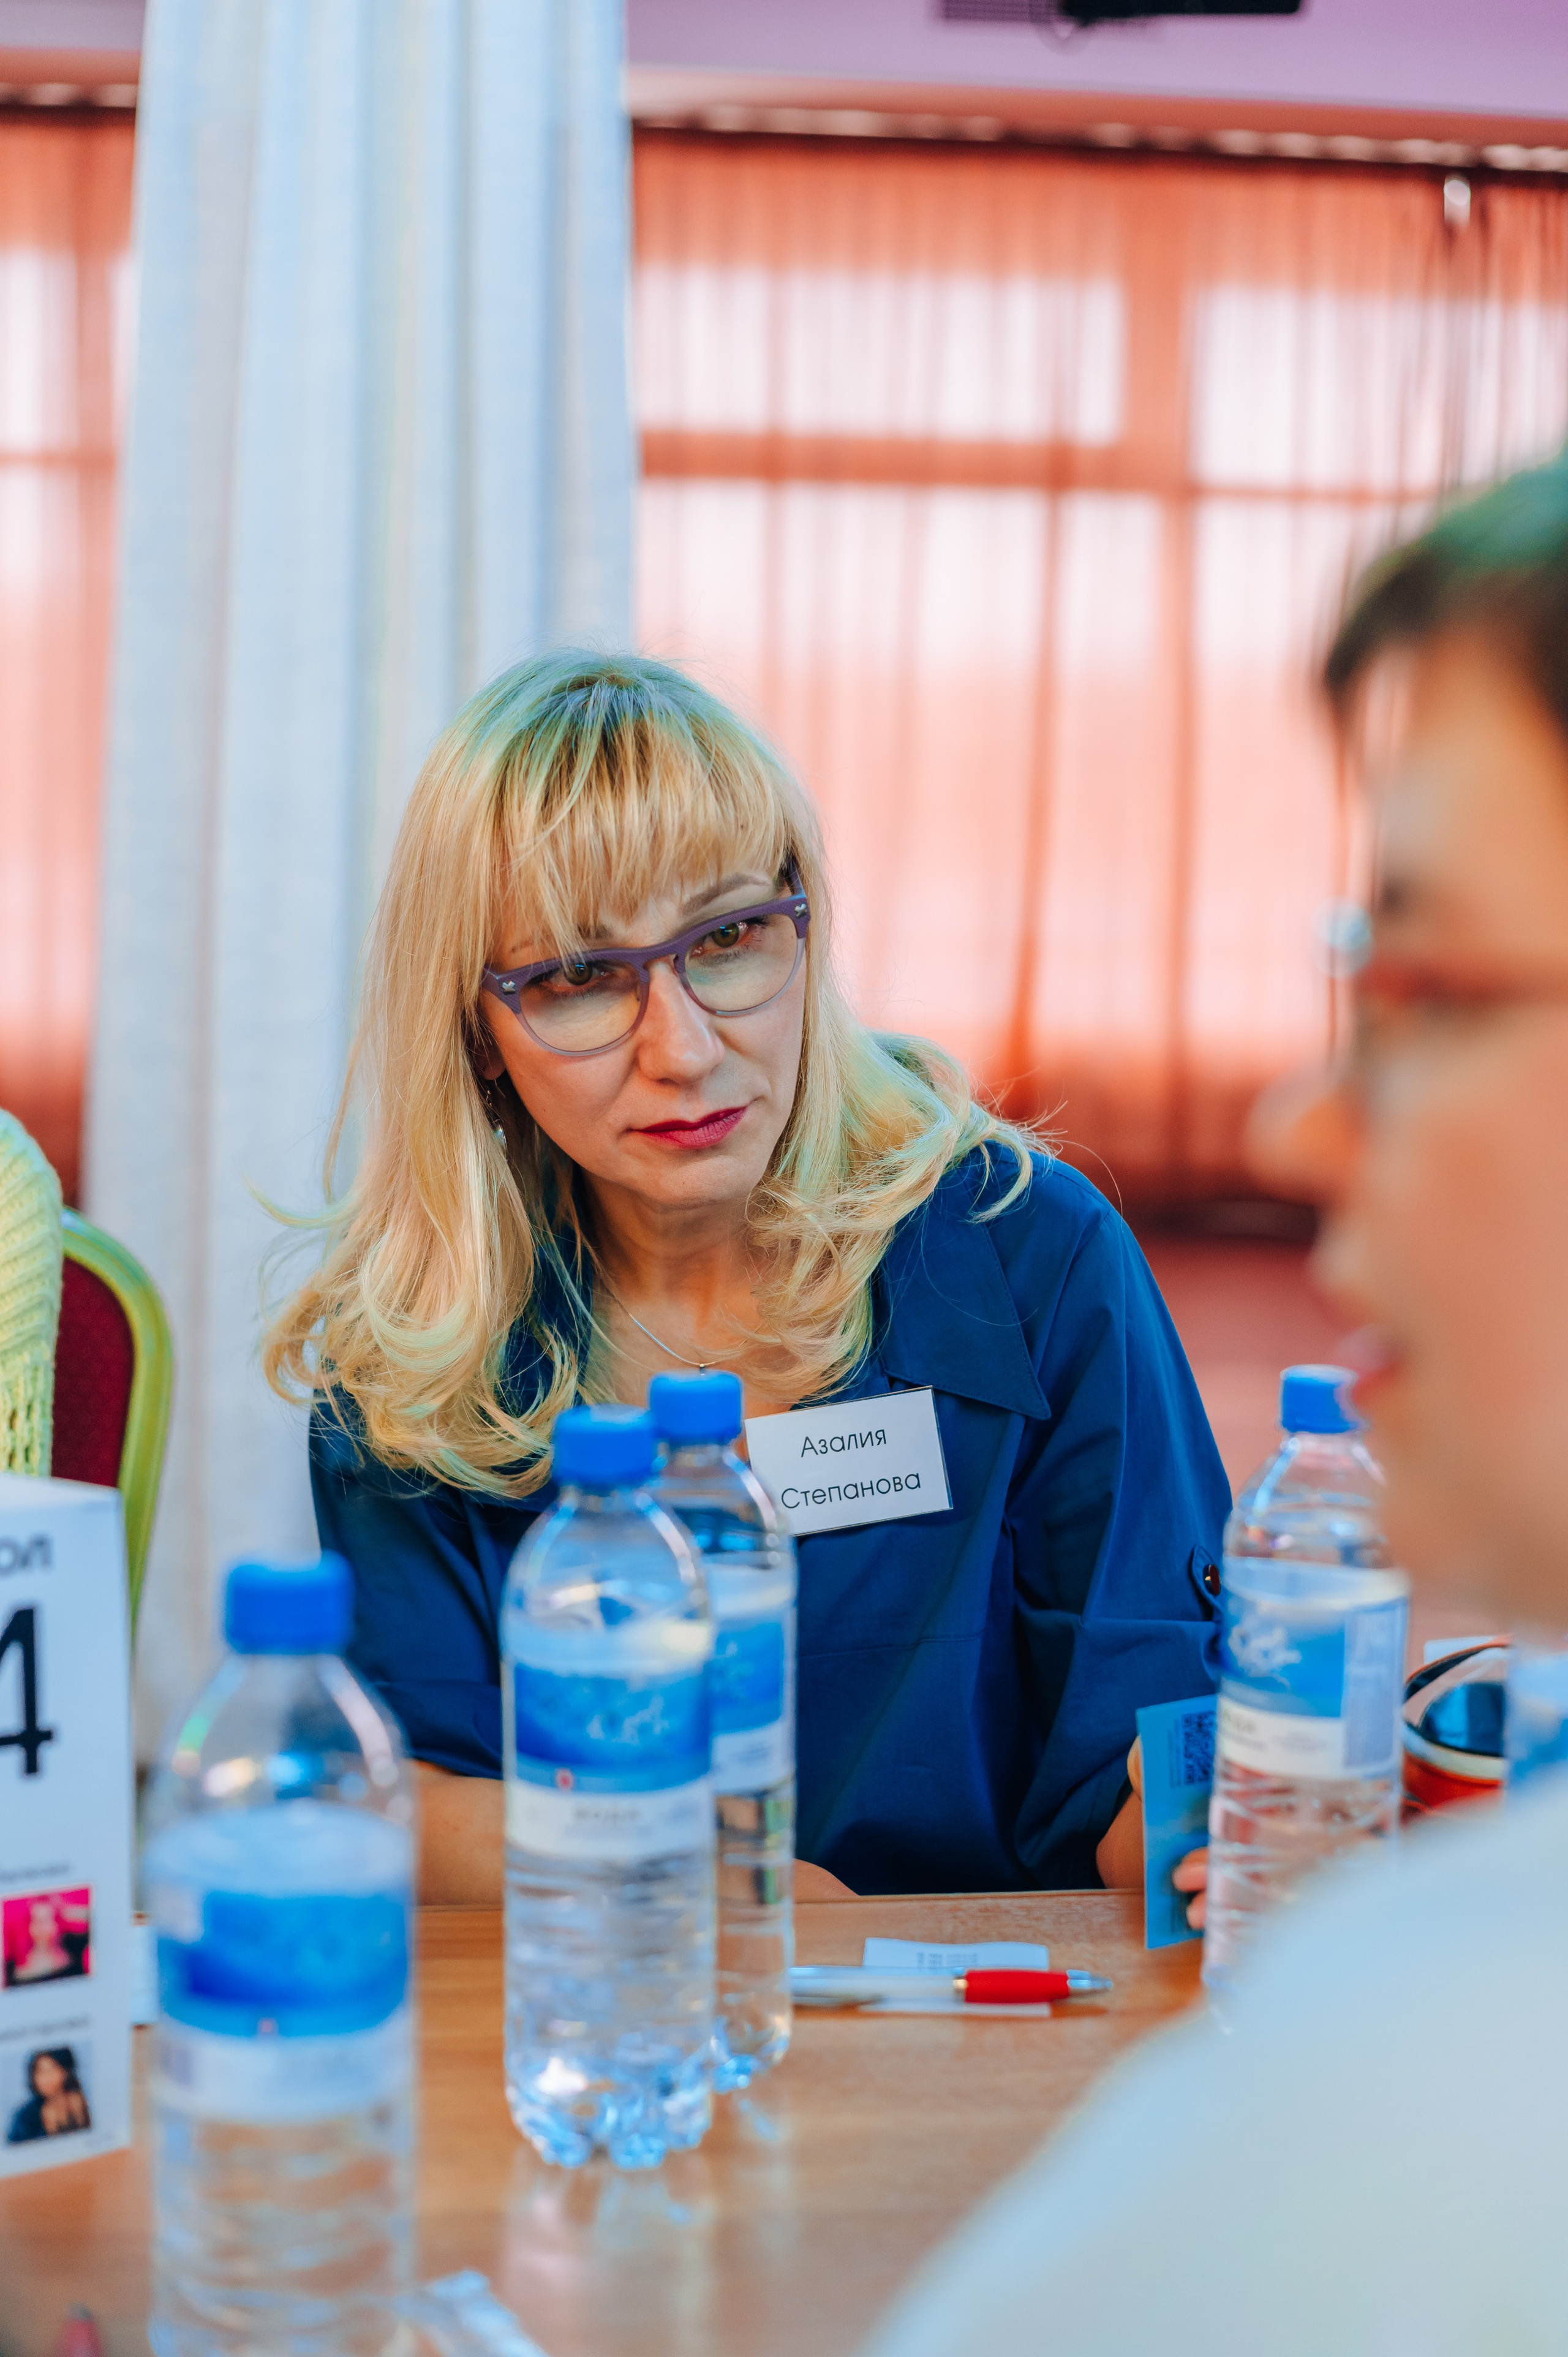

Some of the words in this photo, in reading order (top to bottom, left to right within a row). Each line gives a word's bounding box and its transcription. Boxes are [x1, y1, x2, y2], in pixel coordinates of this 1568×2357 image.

[801, 1428, 888, 1458] Азалия
[780, 1472, 921, 1509] Степанова
[0, 1606, 54, 1776] 4
